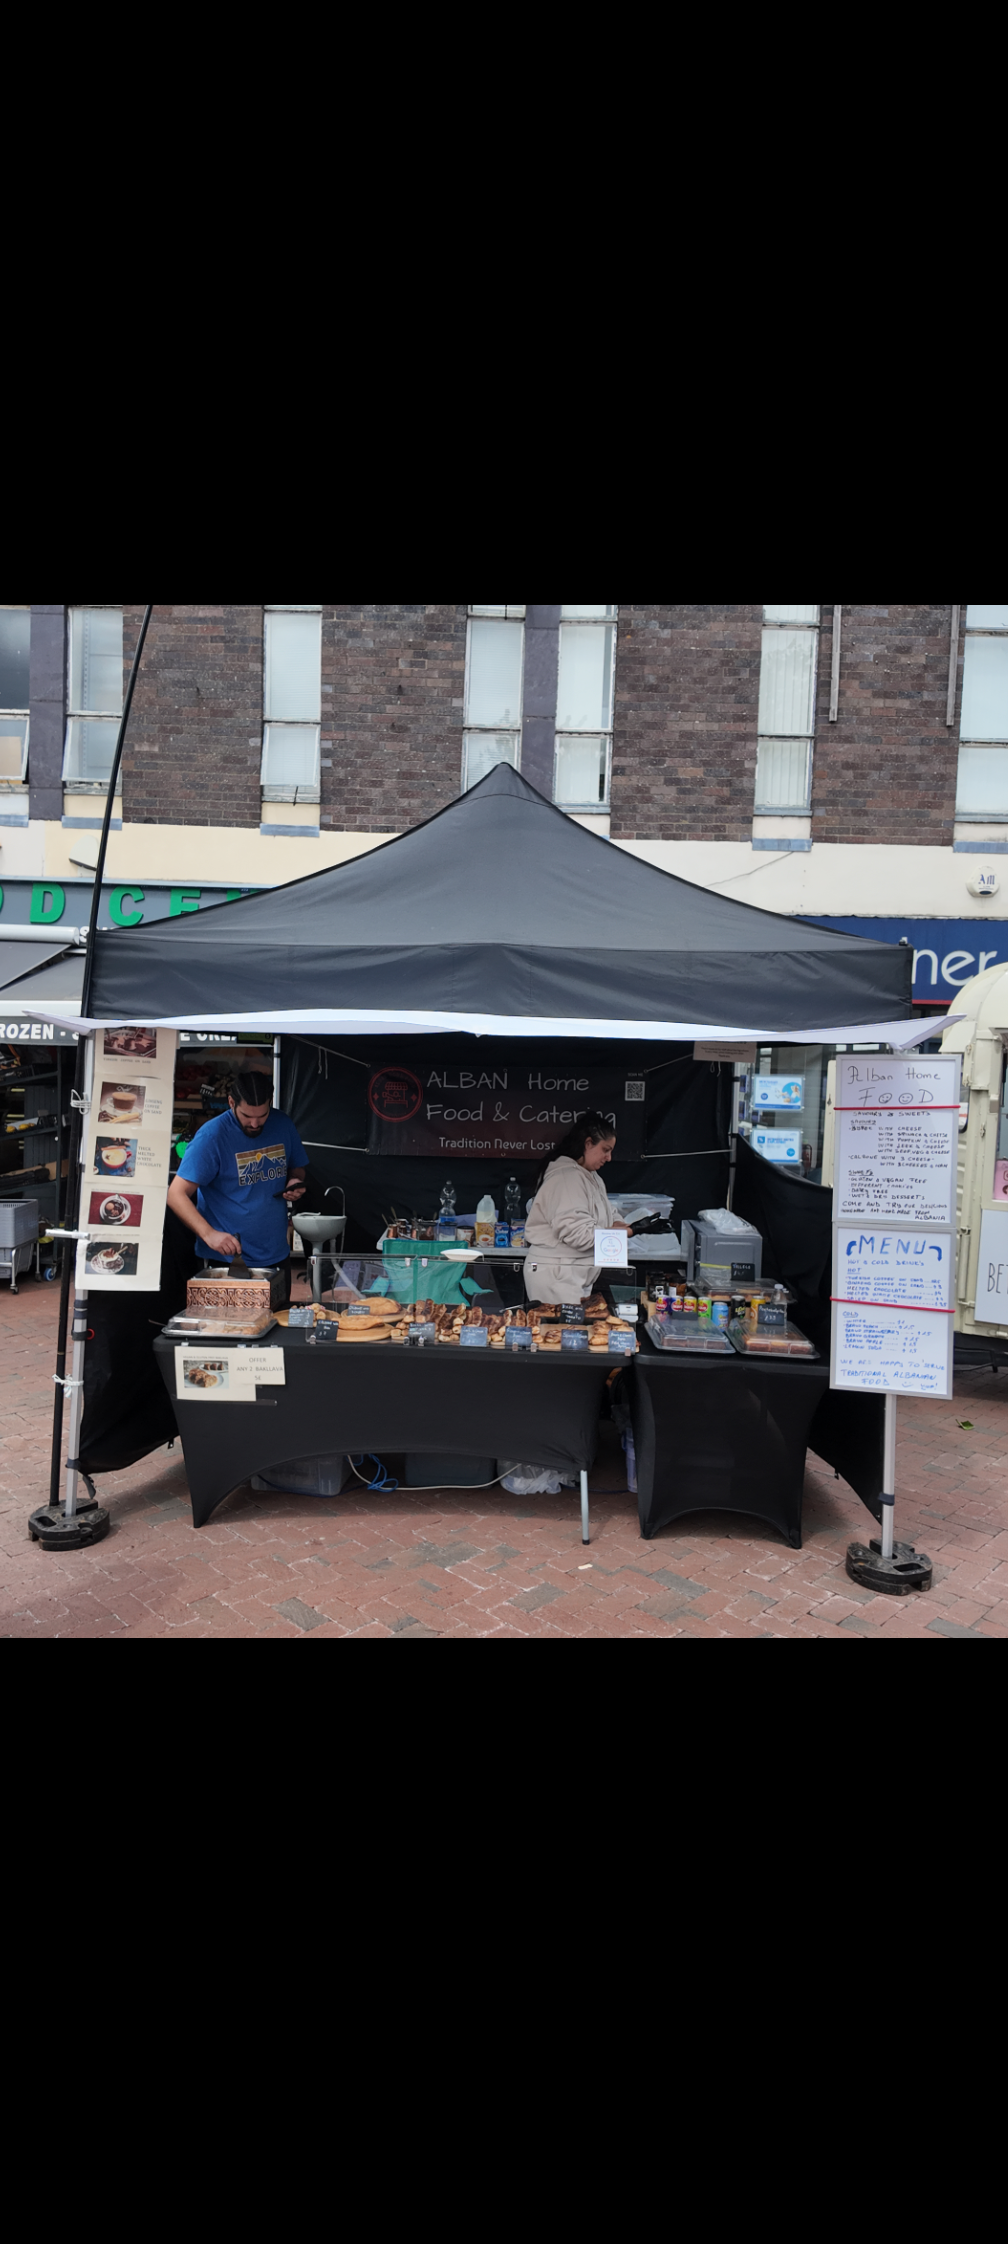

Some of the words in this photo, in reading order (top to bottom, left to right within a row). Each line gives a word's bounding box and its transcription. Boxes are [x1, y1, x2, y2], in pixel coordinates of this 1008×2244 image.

[0, 882, 65, 924] D
[901, 937, 998, 986] ner
[427, 1071, 508, 1090] ALBAN
[528, 1073, 590, 1091] Home
[847, 1065, 893, 1085] Alban
[905, 1067, 941, 1080] Home
[426, 1102, 484, 1121] Food
[492, 1101, 510, 1122] &
[439, 1136, 491, 1149] Tradition
[239, 1165, 288, 1187] EXPLORE
[858, 1234, 927, 1255] MENU
[987, 1262, 1008, 1294] BE
[840, 1368, 887, 1378] TRADITIONAL
[893, 1371, 937, 1381] ALBANIAN
[861, 1378, 890, 1386] FOOD
